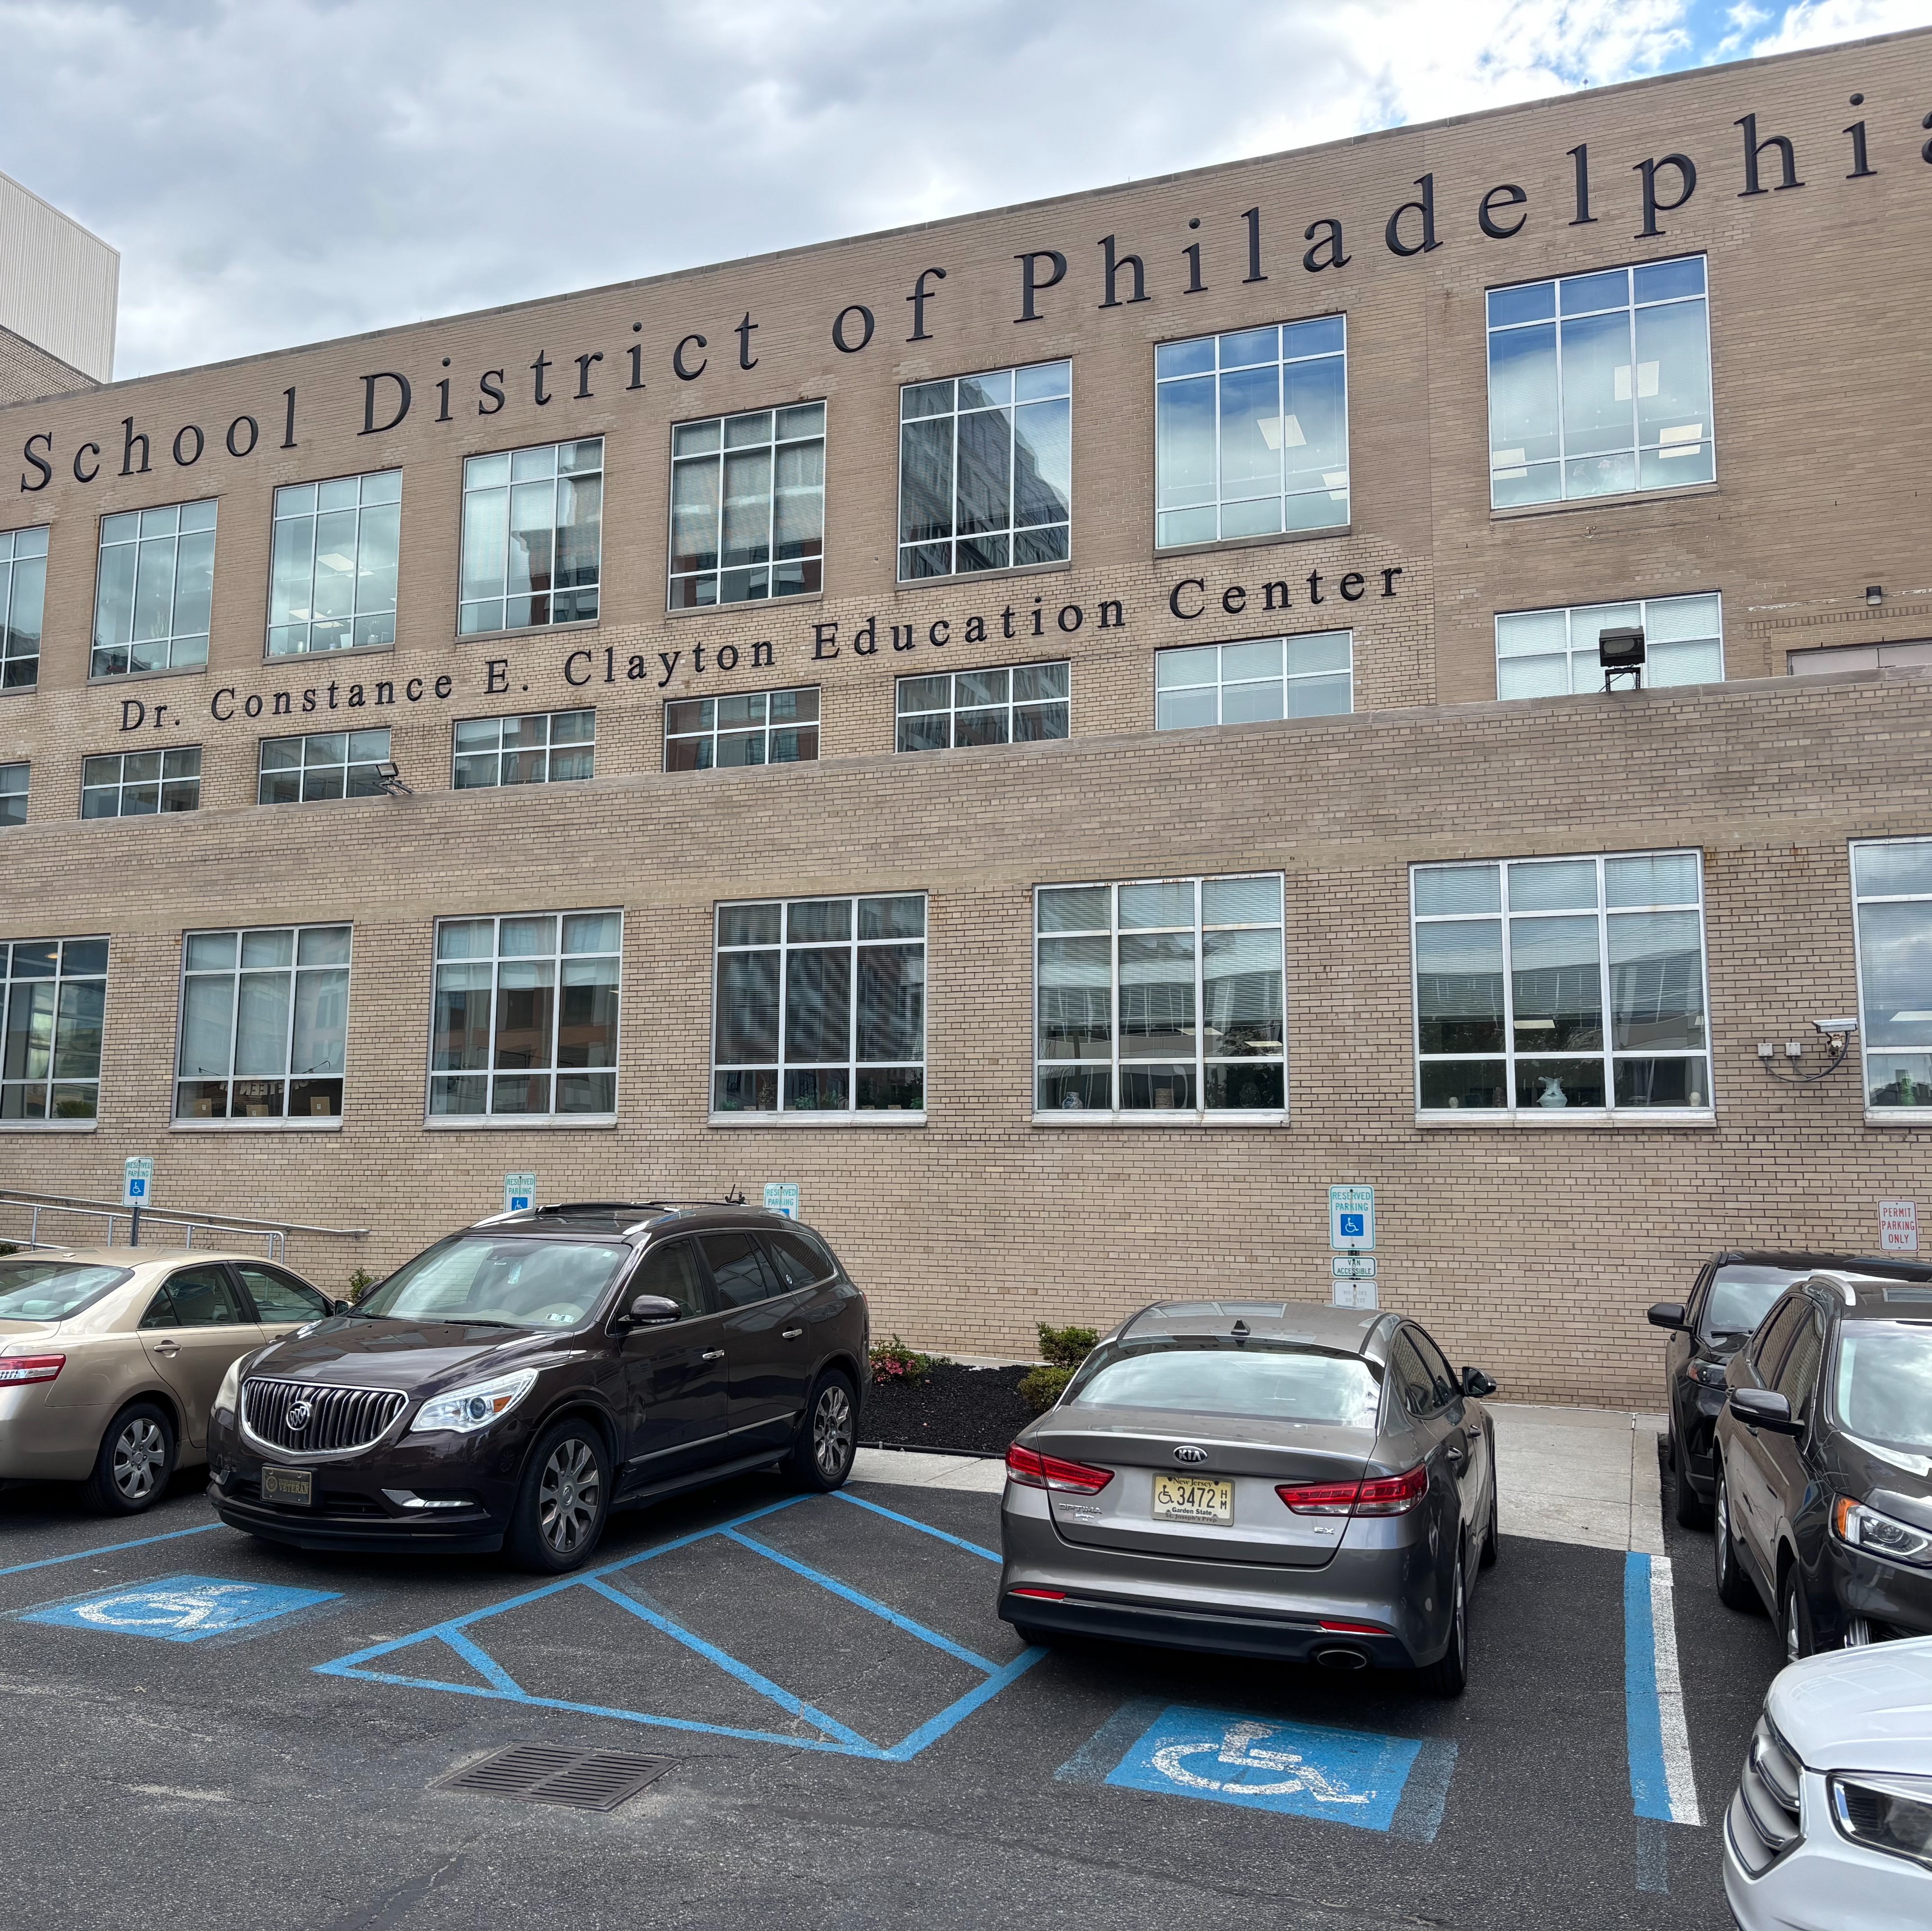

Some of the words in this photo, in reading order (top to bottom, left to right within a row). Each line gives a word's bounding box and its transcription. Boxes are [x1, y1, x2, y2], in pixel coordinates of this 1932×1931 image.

[21, 386, 297, 493] School
[357, 311, 758, 436] District
[832, 267, 947, 353] of
[1013, 93, 1932, 324] Philadelphi
[119, 700, 180, 731] Dr.
[211, 675, 454, 721] Constance
[484, 659, 529, 694] E.
[564, 640, 776, 687] Clayton
[811, 595, 1125, 660] Education
[1169, 567, 1402, 619] Center
[1332, 1191, 1371, 1200] RESERVED
[1335, 1203, 1368, 1211] PARKING
[1883, 1208, 1911, 1217] PERMIT
[1882, 1221, 1915, 1231] PARKING
[1888, 1234, 1909, 1243] ONLY
[1178, 1449, 1202, 1461] KIA
[1190, 1479, 1213, 1487] Jersey
[279, 1483, 309, 1495] VETERAN
[1177, 1486, 1215, 1509] 3472
[1059, 1503, 1102, 1514] OPTIMA
